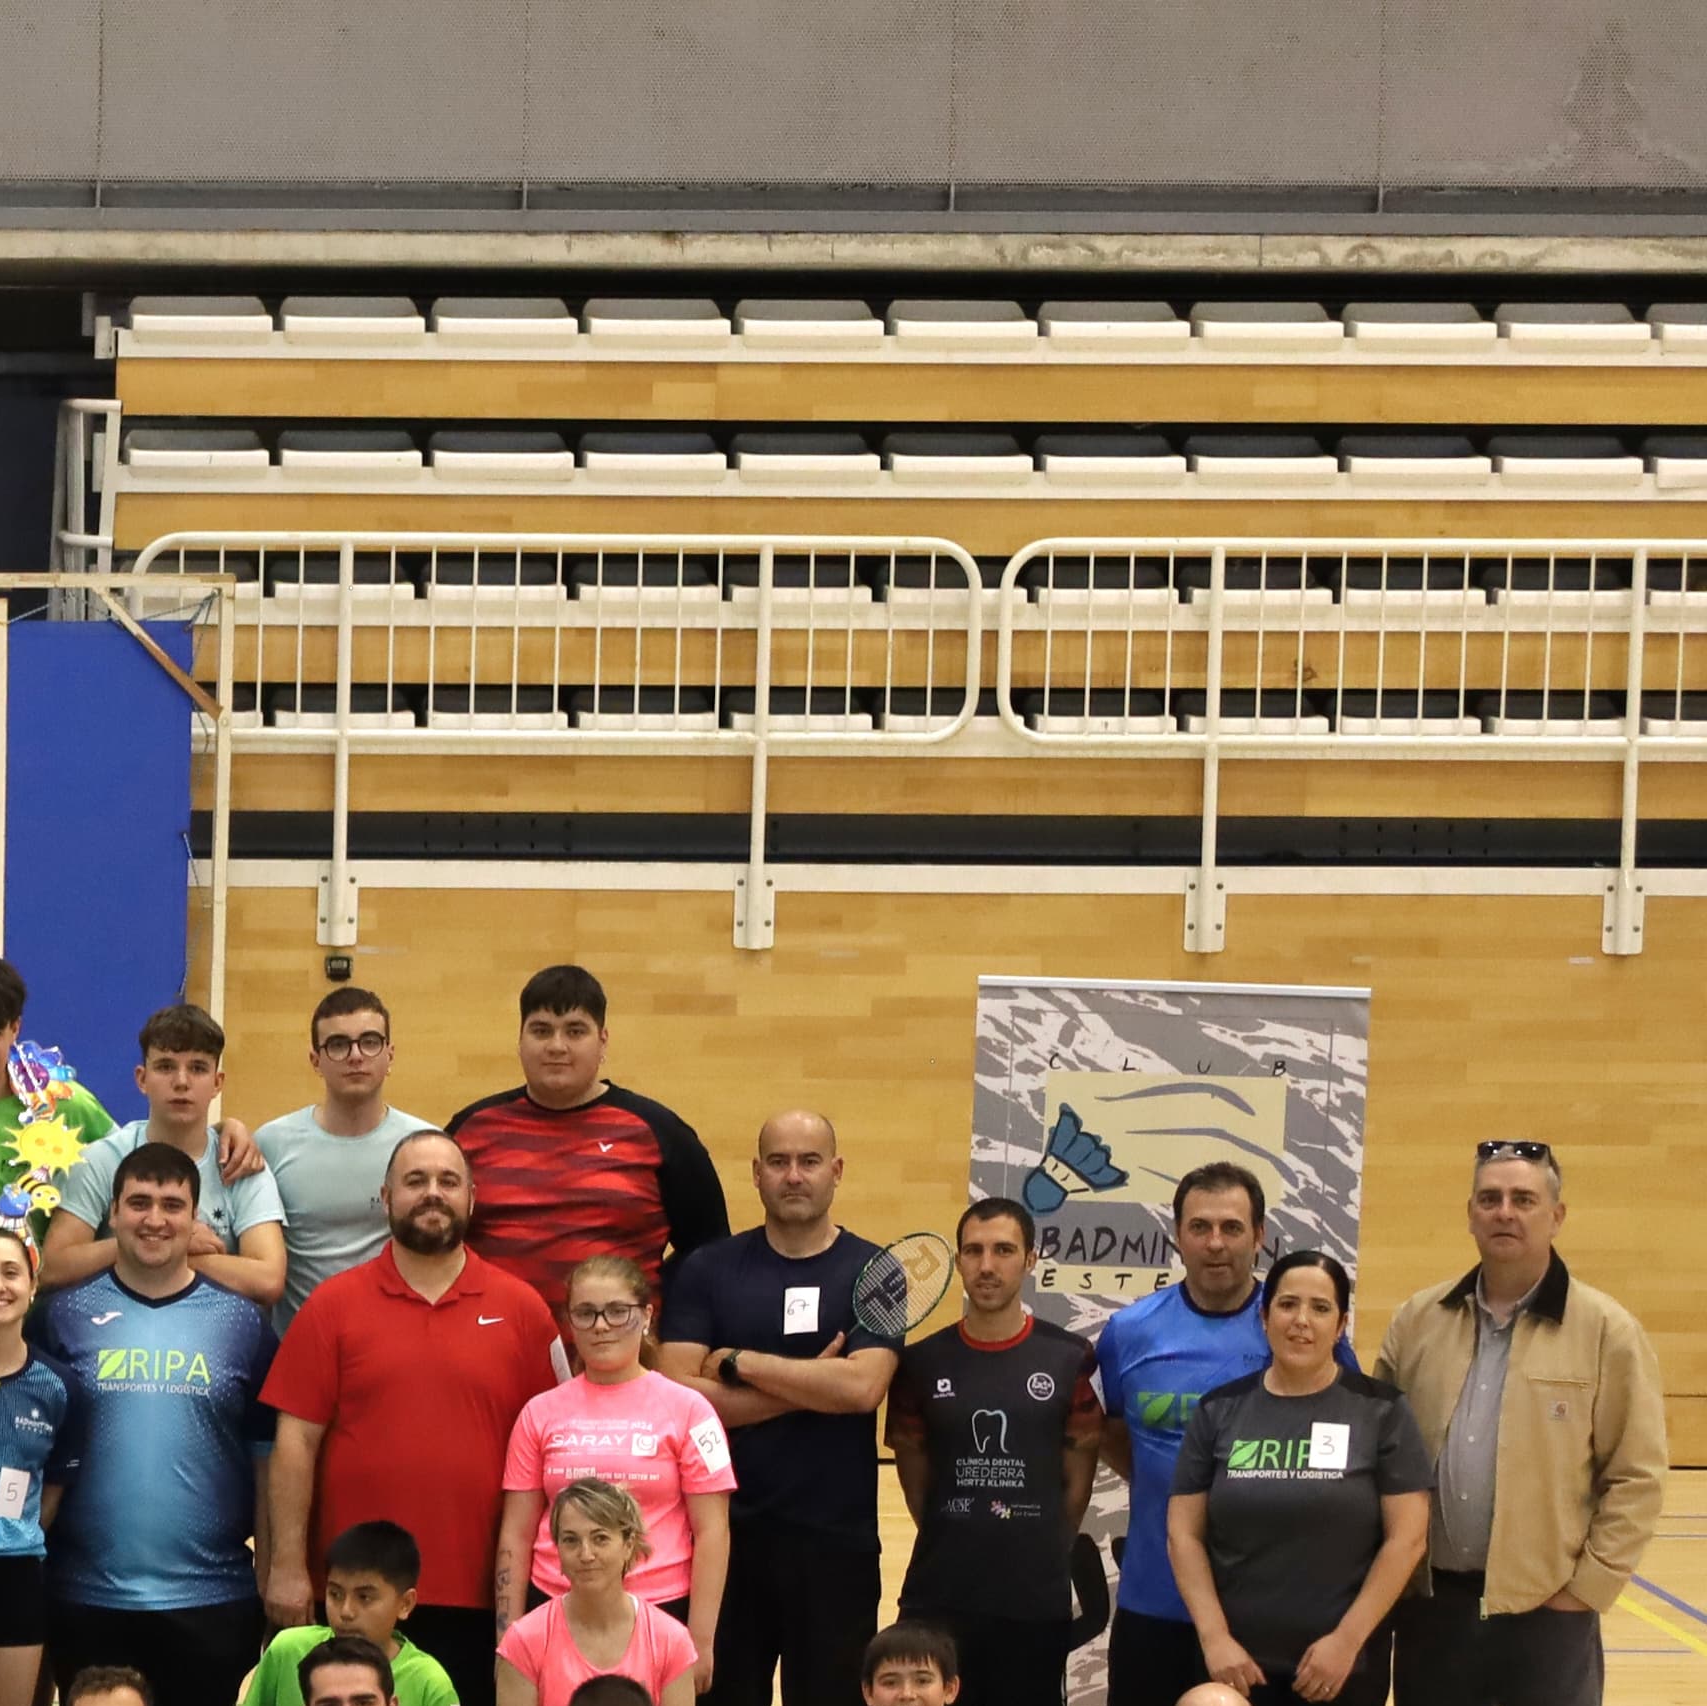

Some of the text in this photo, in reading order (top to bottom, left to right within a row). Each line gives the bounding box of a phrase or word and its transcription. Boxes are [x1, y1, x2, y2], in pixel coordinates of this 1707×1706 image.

[1049, 1052, 1287, 1077] CLUB
[1042, 1268, 1169, 1289] ESTE
[129, 1348, 212, 1385] RIPA
[97, 1382, 157, 1394] TRANSPORTES
[159, 1383, 166, 1392] Y
[549, 1432, 628, 1449] SARAY
[698, 1430, 722, 1454] 52
[1318, 1435, 1336, 1455] 3
[992, 1458, 1026, 1468] DENTAL
[955, 1467, 1026, 1480] UREDERRA
[1227, 1469, 1288, 1480] TRANSPORTES
[1289, 1470, 1296, 1479] Y
[5, 1482, 19, 1502] 5
[987, 1479, 1025, 1489] KLINIKA
